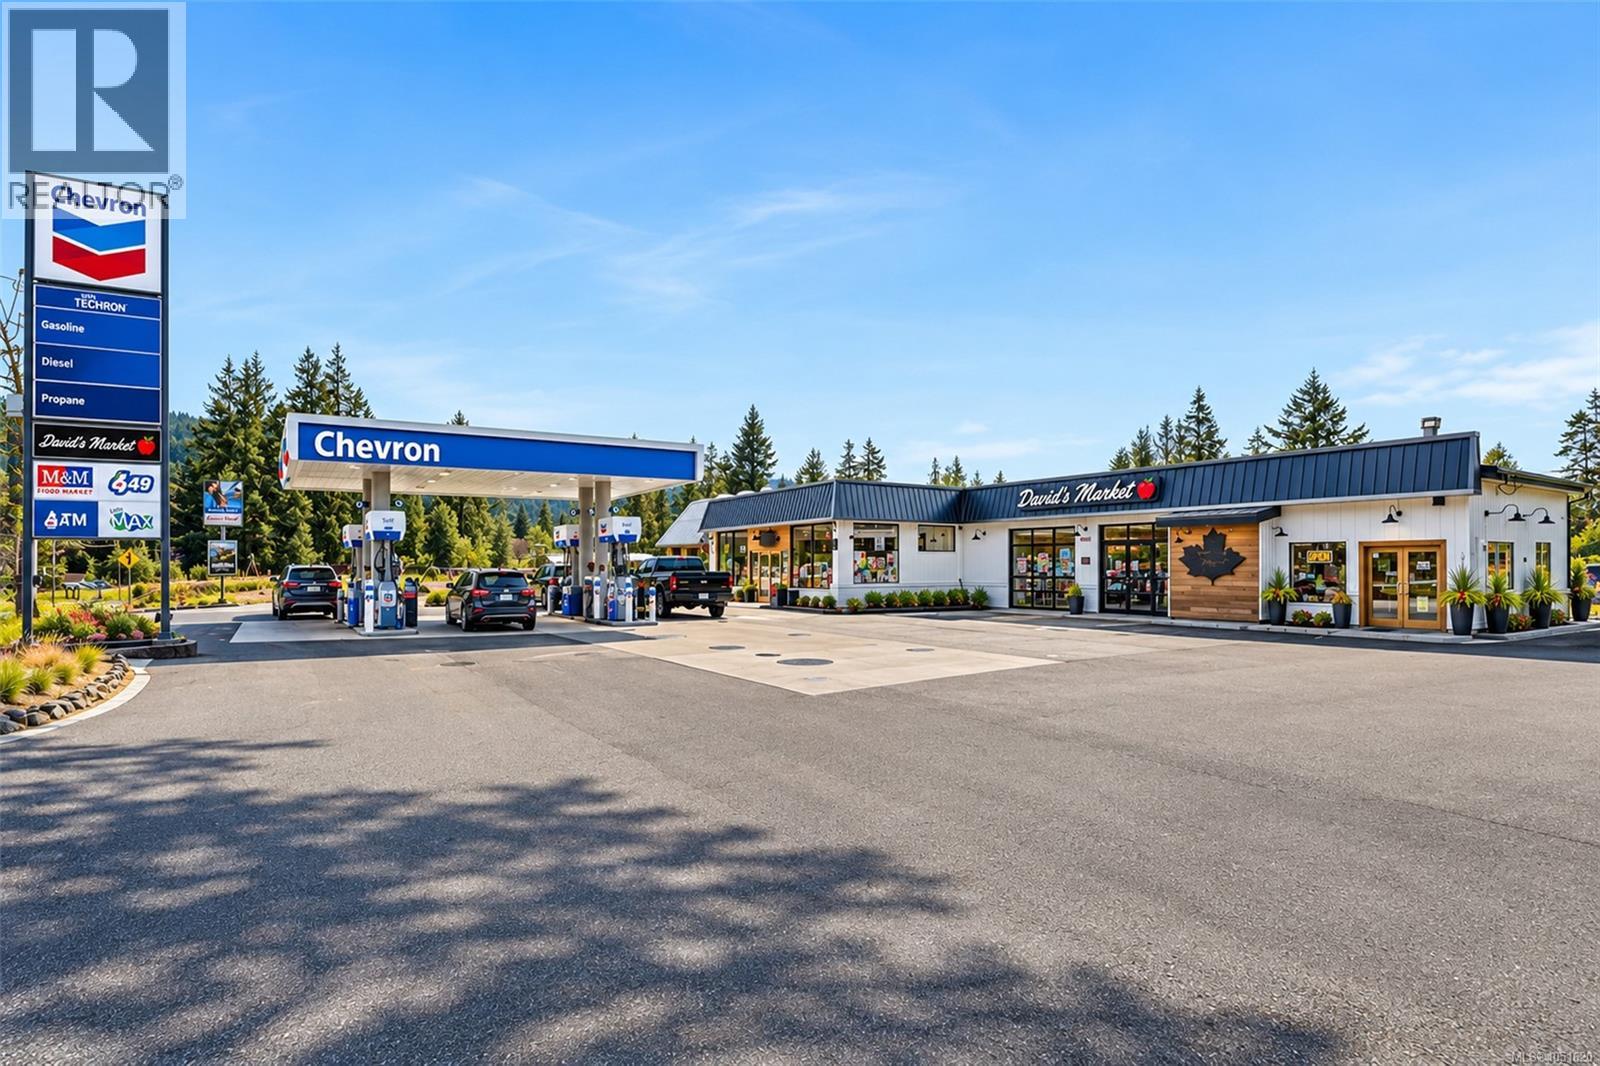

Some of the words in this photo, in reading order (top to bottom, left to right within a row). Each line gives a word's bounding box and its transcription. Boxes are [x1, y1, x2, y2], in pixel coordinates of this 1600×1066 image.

[51, 185, 146, 217] Chevron
[74, 297, 126, 312] TECHRON
[41, 320, 85, 333] Gasoline
[41, 357, 74, 368] Diesel
[41, 393, 85, 406] Propane
[38, 434, 86, 449] David's
[88, 436, 136, 452] Market
[314, 430, 440, 462] Chevron
[41, 469, 90, 485] M&M
[1017, 486, 1070, 508] David's
[1074, 480, 1136, 503] Market
[59, 512, 87, 527] ATM
[110, 512, 153, 531] MAX
